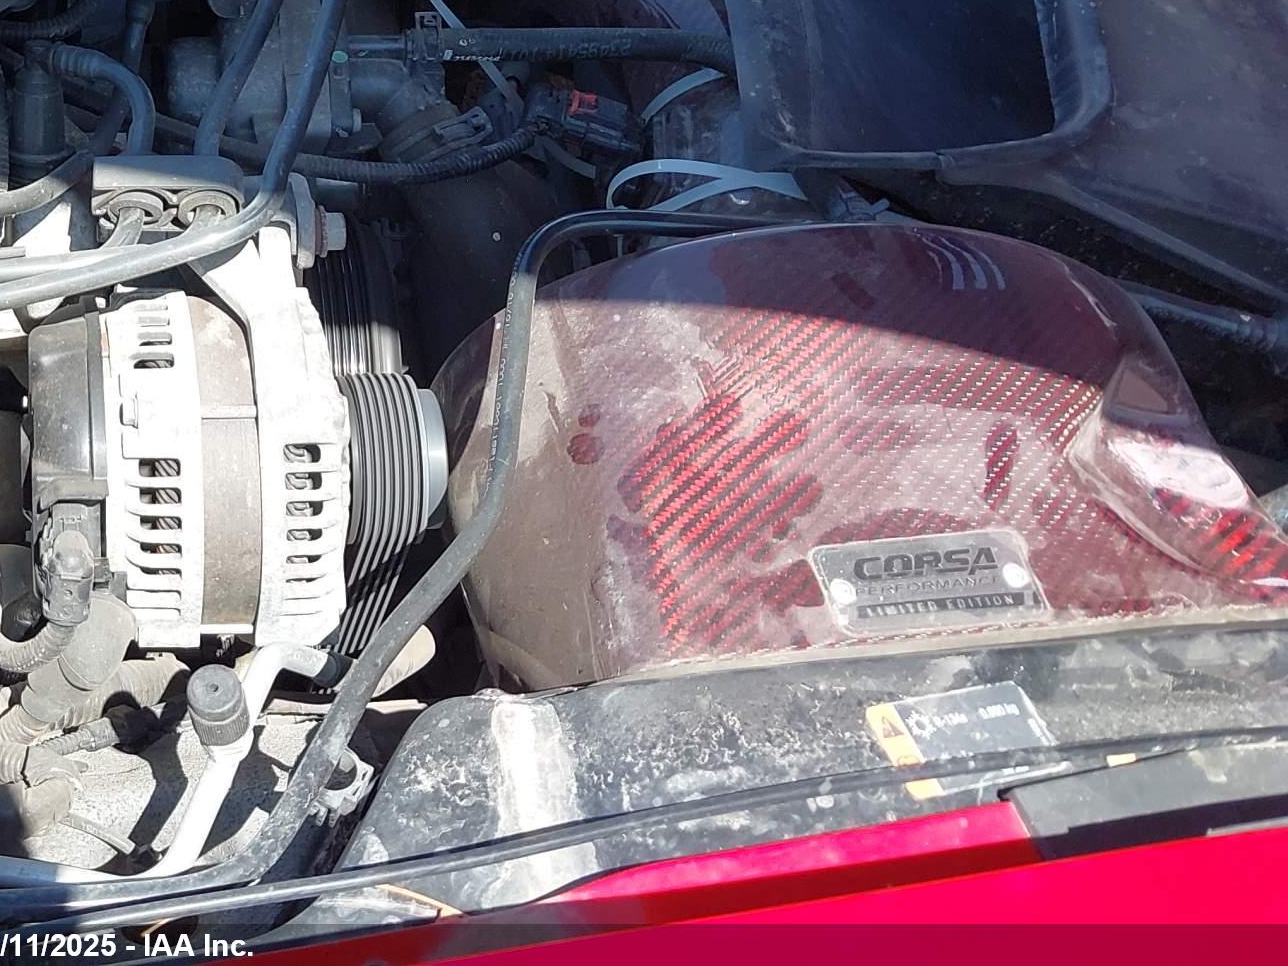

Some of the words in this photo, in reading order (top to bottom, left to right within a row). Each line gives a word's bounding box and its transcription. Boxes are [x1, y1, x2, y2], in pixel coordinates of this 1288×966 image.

[853, 546, 999, 581] CORSA
[865, 600, 938, 617] LIMITED
[946, 595, 1015, 610] EDITION
